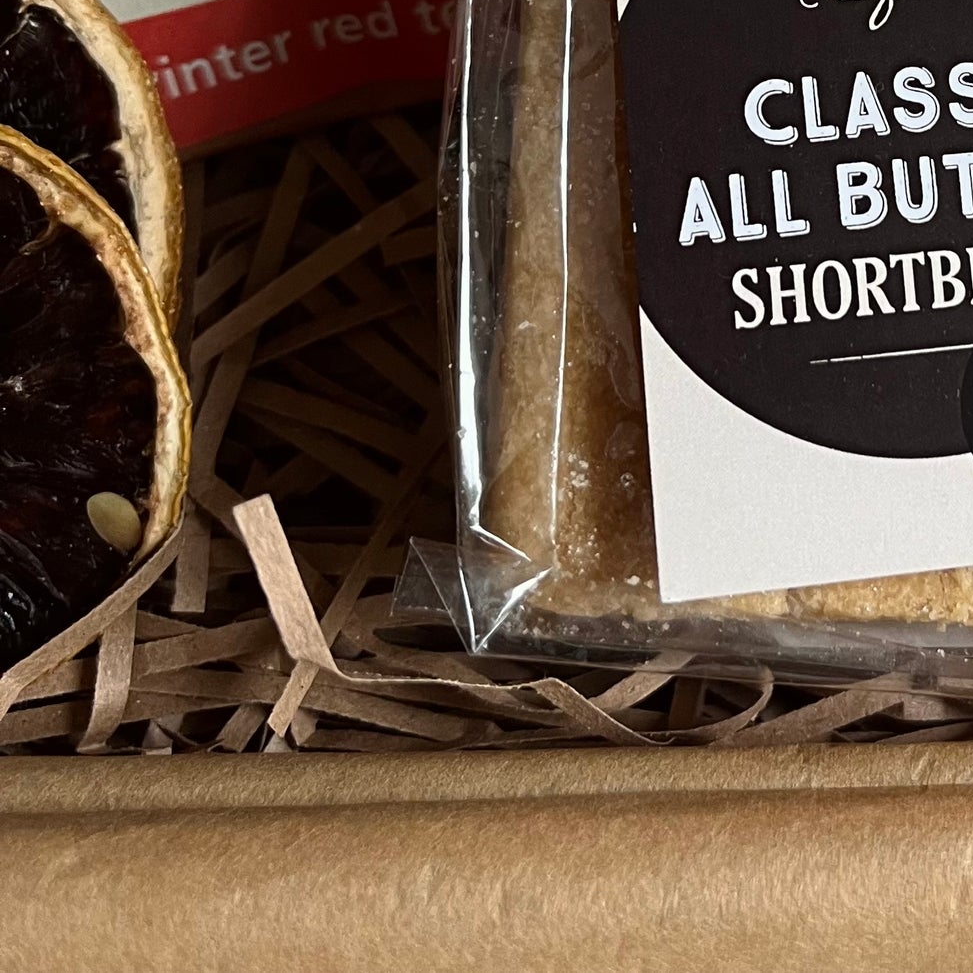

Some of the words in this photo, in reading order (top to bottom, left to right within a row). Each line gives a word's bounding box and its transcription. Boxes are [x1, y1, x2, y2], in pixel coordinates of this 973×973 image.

[154, 30, 292, 100] inter
[310, 0, 399, 50] red
[678, 169, 811, 247] ALL
